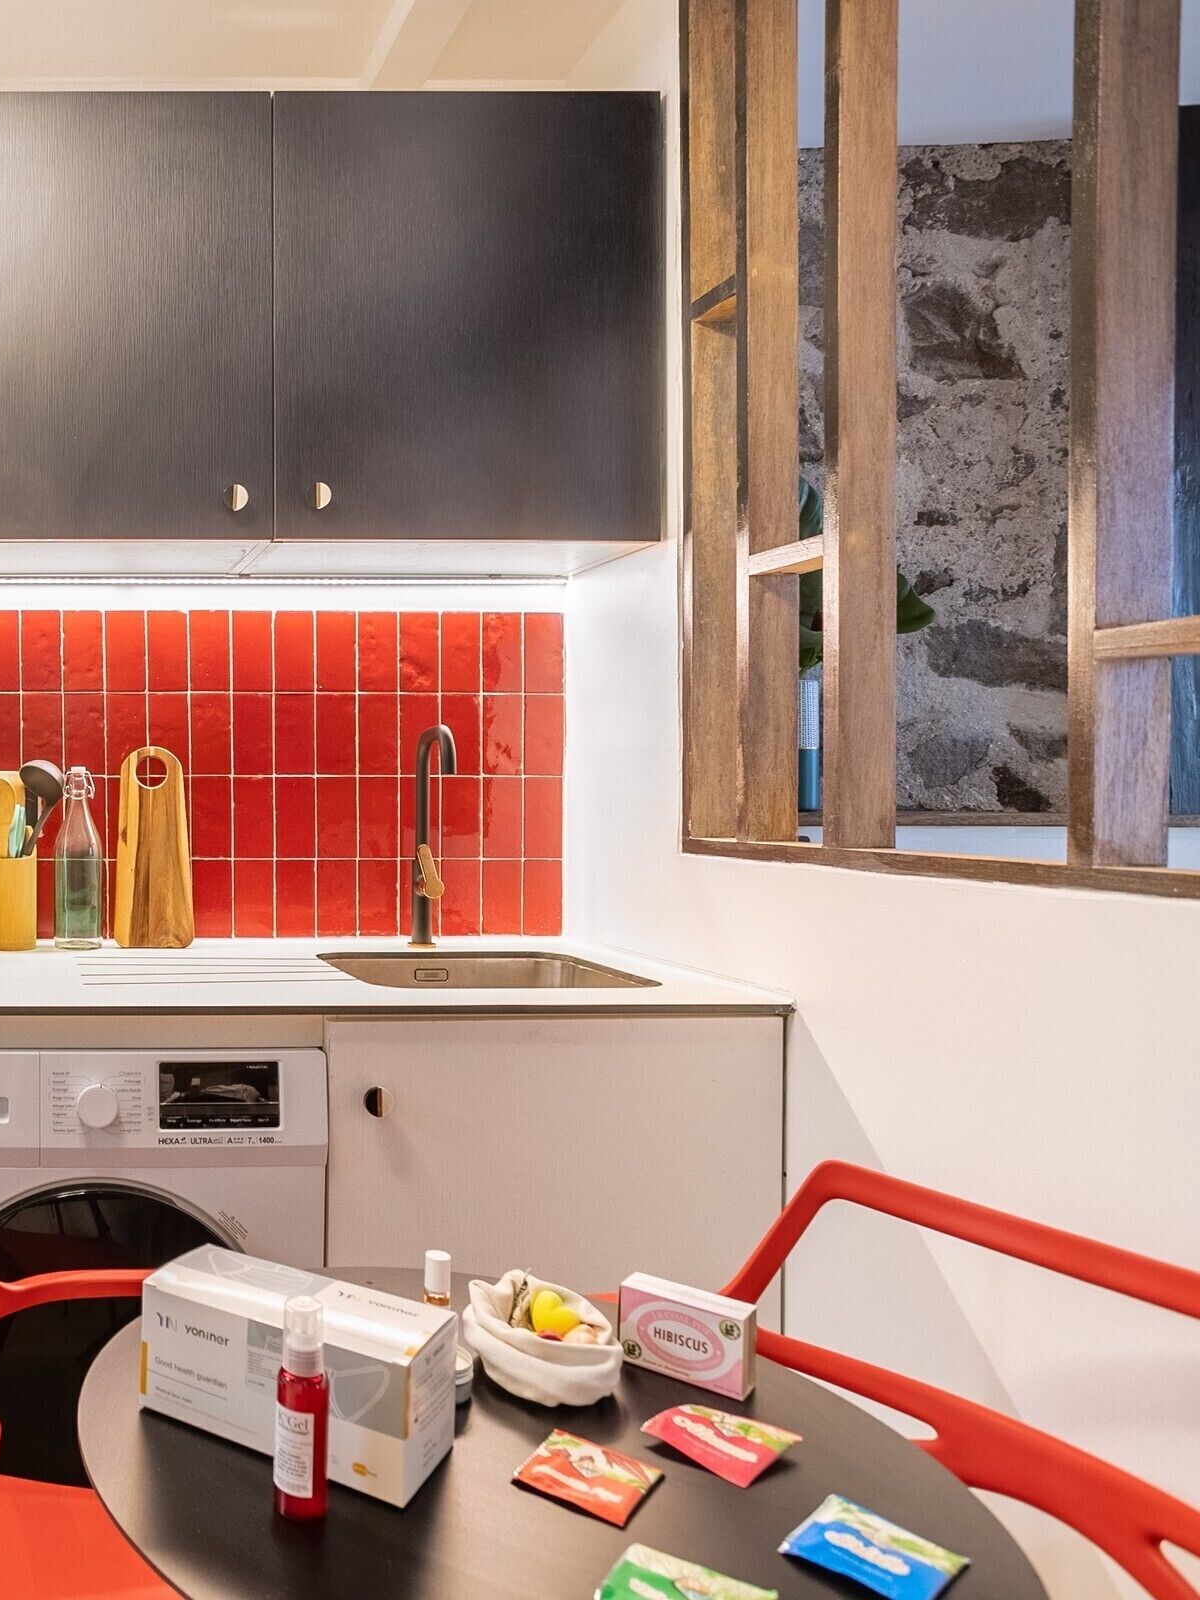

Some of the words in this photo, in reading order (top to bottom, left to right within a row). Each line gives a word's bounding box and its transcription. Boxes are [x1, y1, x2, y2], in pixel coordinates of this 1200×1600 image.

[190, 1137, 213, 1145] ULTRA
[184, 1324, 231, 1346] yoniner
[653, 1326, 709, 1354] HIBISCUS
[155, 1356, 173, 1369] Good
[174, 1364, 196, 1379] health
